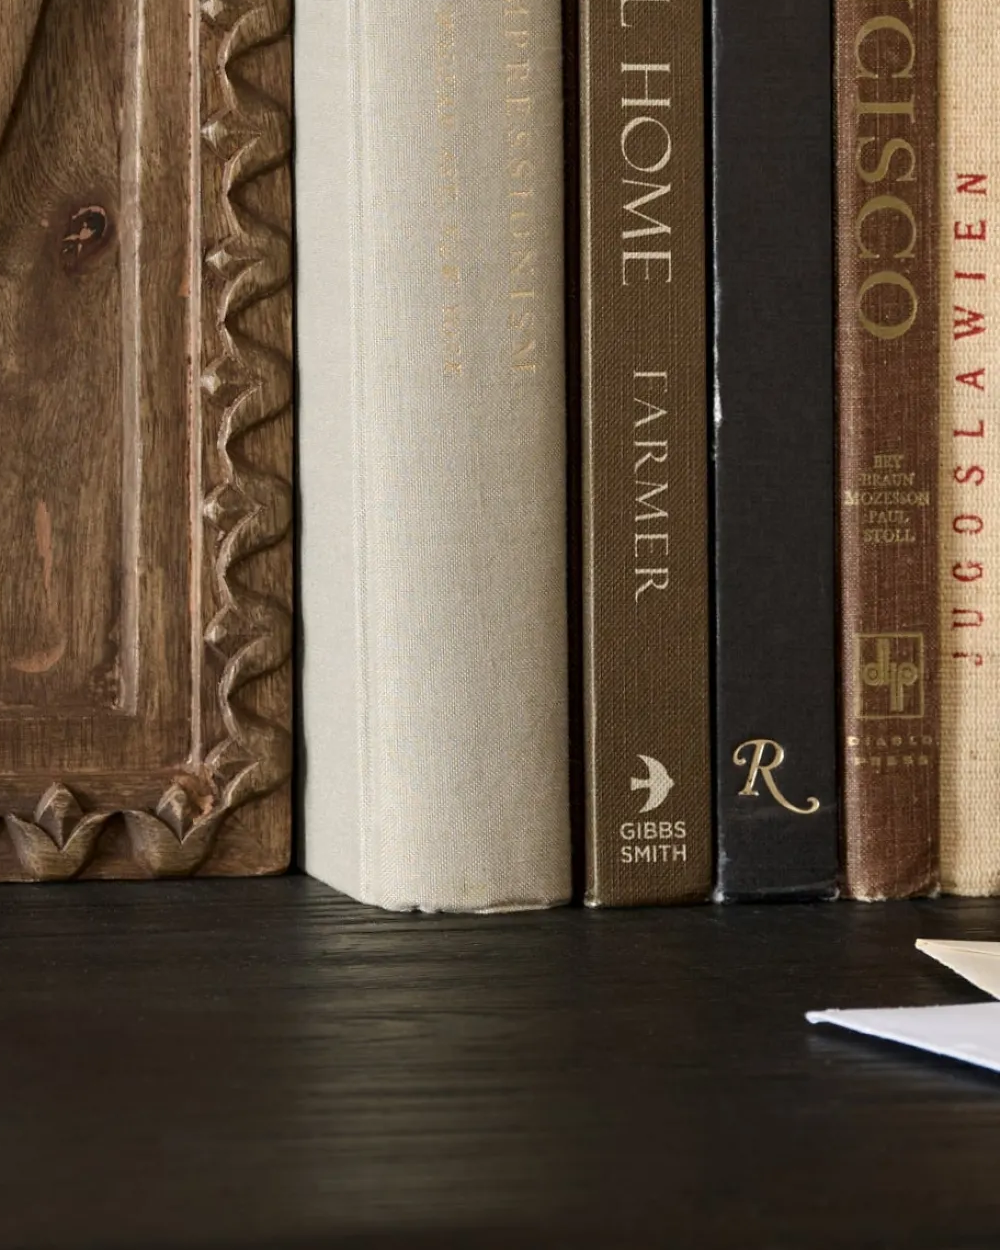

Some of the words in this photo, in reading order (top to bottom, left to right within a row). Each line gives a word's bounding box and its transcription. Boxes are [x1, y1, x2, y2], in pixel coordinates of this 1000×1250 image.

[620, 61, 672, 287] HOME
[632, 370, 670, 603] FARMER
[732, 738, 820, 815] R
[619, 820, 687, 841] GIBBS
[620, 844, 687, 864] SMITH
